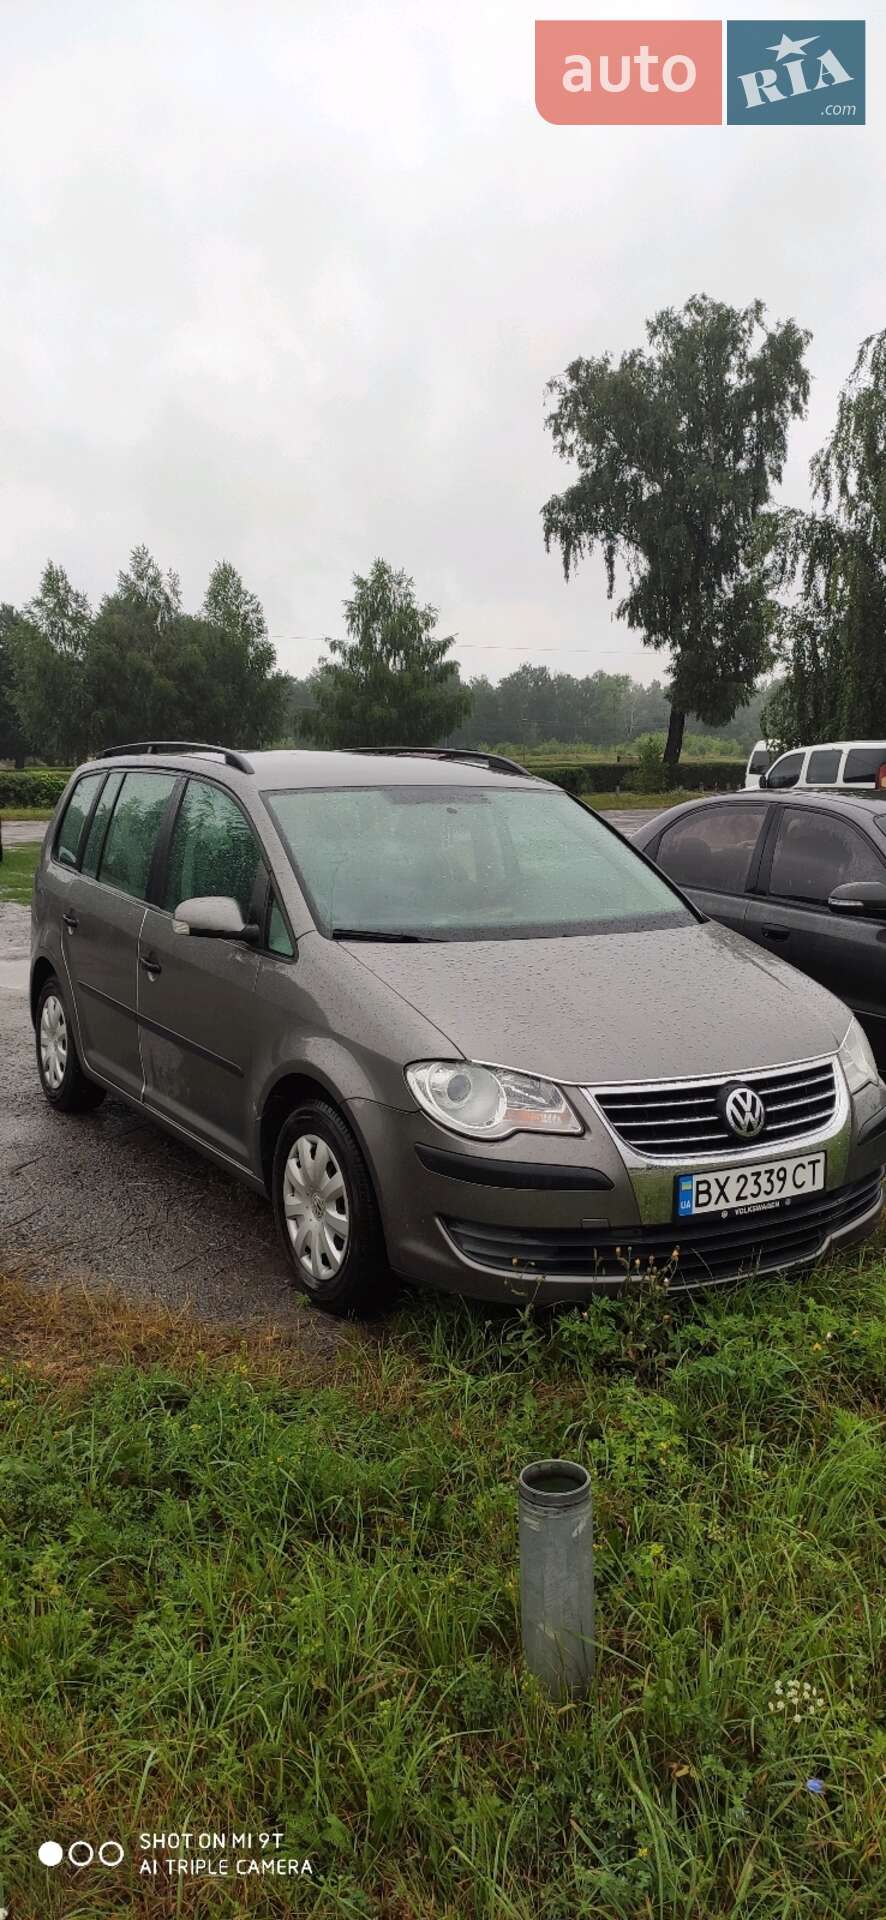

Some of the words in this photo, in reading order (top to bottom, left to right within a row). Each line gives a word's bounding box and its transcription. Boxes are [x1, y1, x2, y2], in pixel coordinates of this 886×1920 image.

[695, 1176, 730, 1207] BX
[736, 1167, 787, 1202] 2339
[792, 1159, 821, 1189] CT
[680, 1200, 691, 1209] UA
